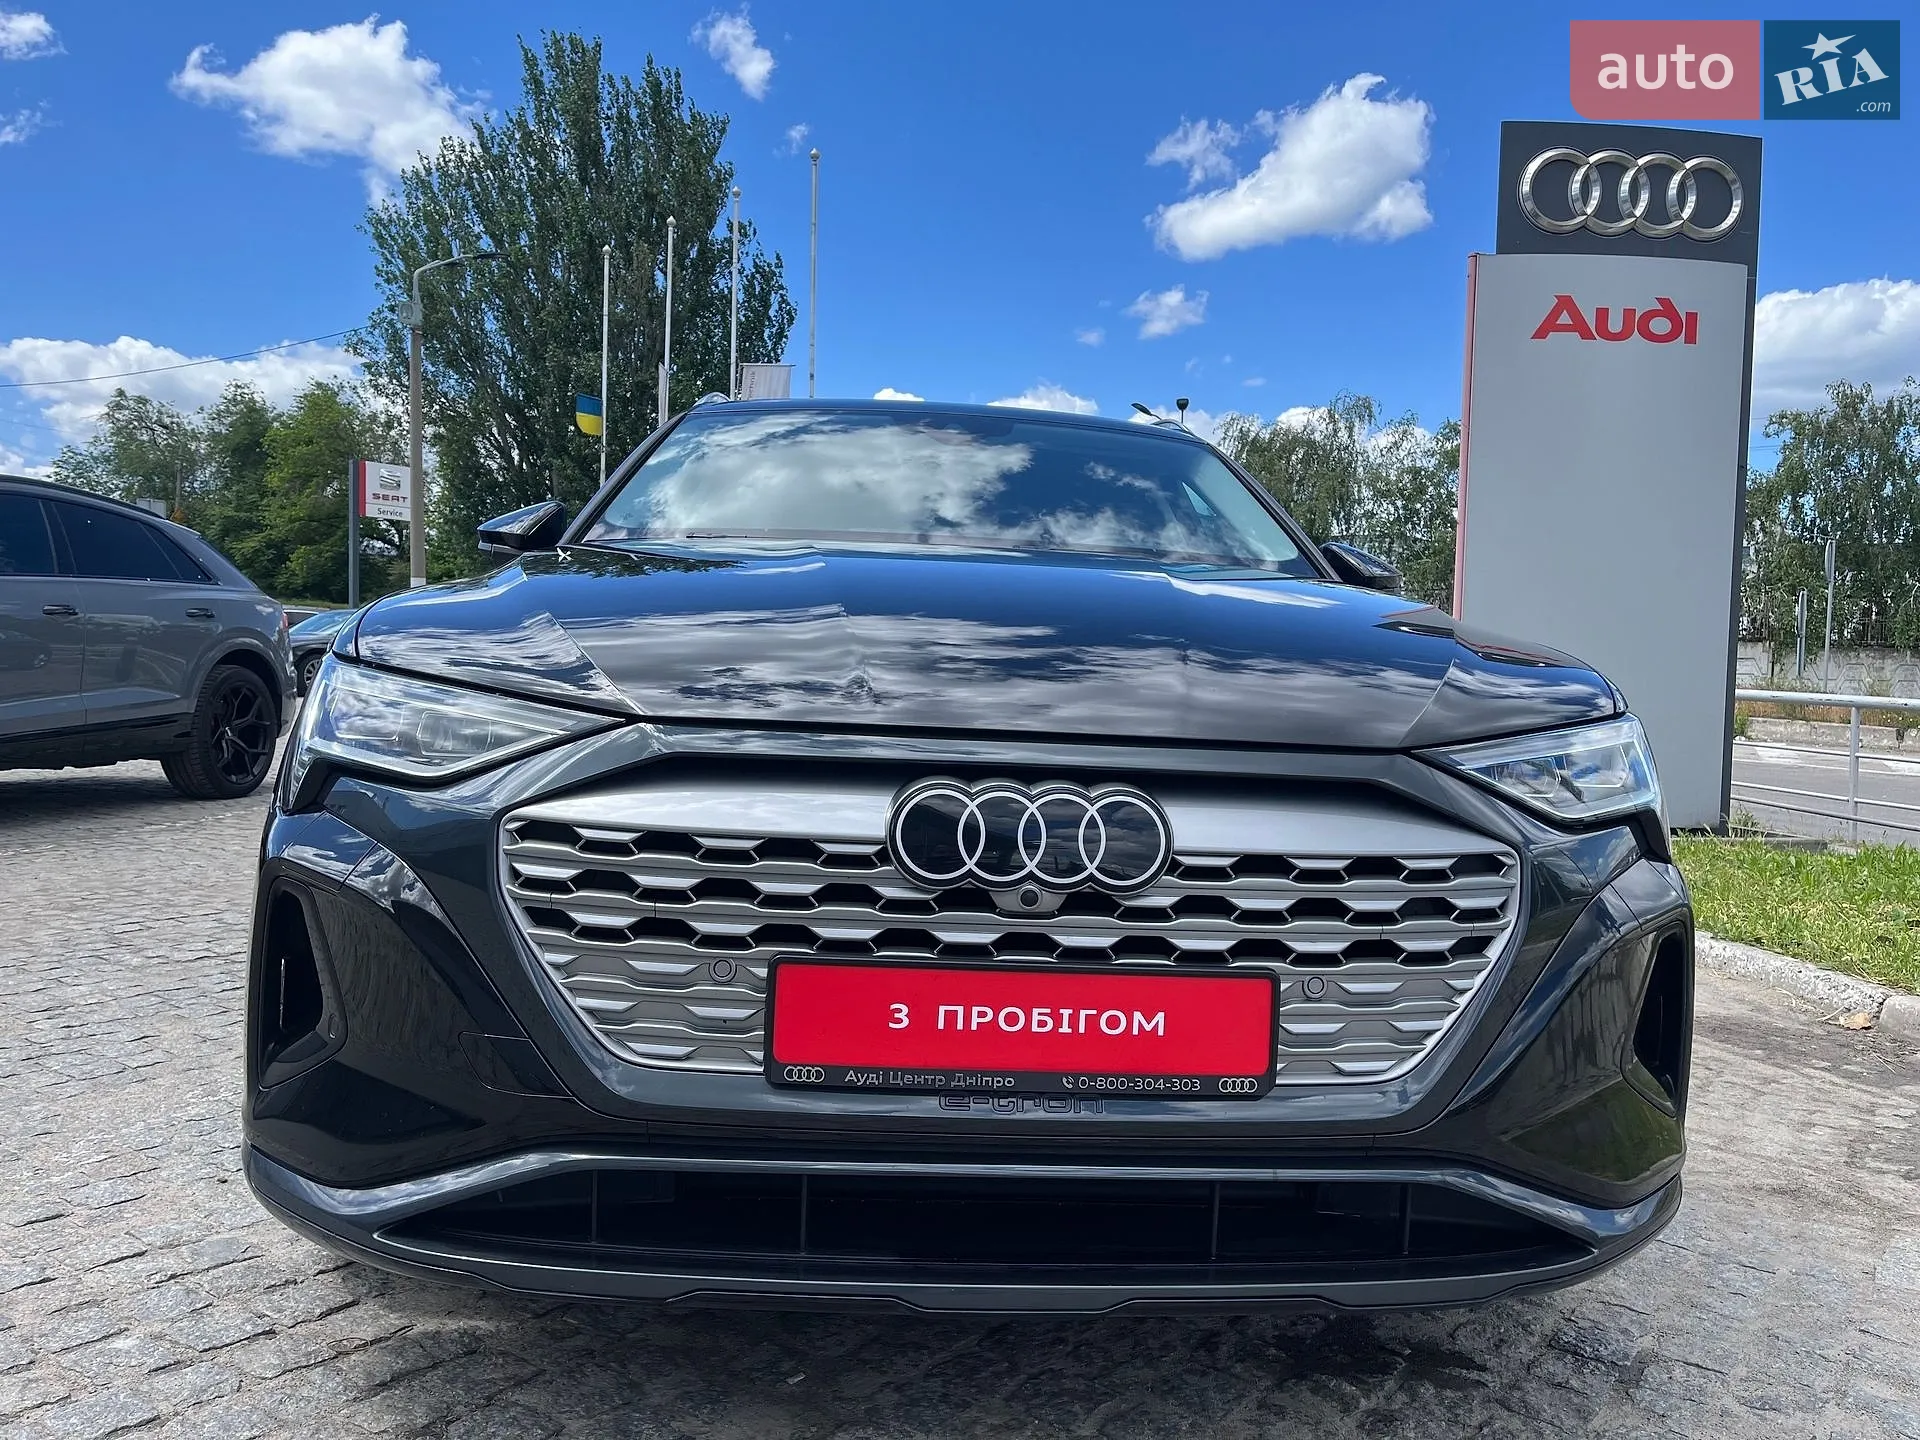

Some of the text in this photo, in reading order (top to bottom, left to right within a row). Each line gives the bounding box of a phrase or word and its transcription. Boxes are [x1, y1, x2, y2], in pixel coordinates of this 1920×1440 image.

[1530, 294, 1699, 345] Audi
[372, 493, 408, 503] SEAT
[377, 507, 403, 517] Service
[937, 1005, 1165, 1036] ПРОБІГОМ
[844, 1070, 1016, 1088] Ауді Центр Дніпро
[1078, 1076, 1201, 1091] 0-800-304-303
[938, 1091, 1104, 1114] e-tron
